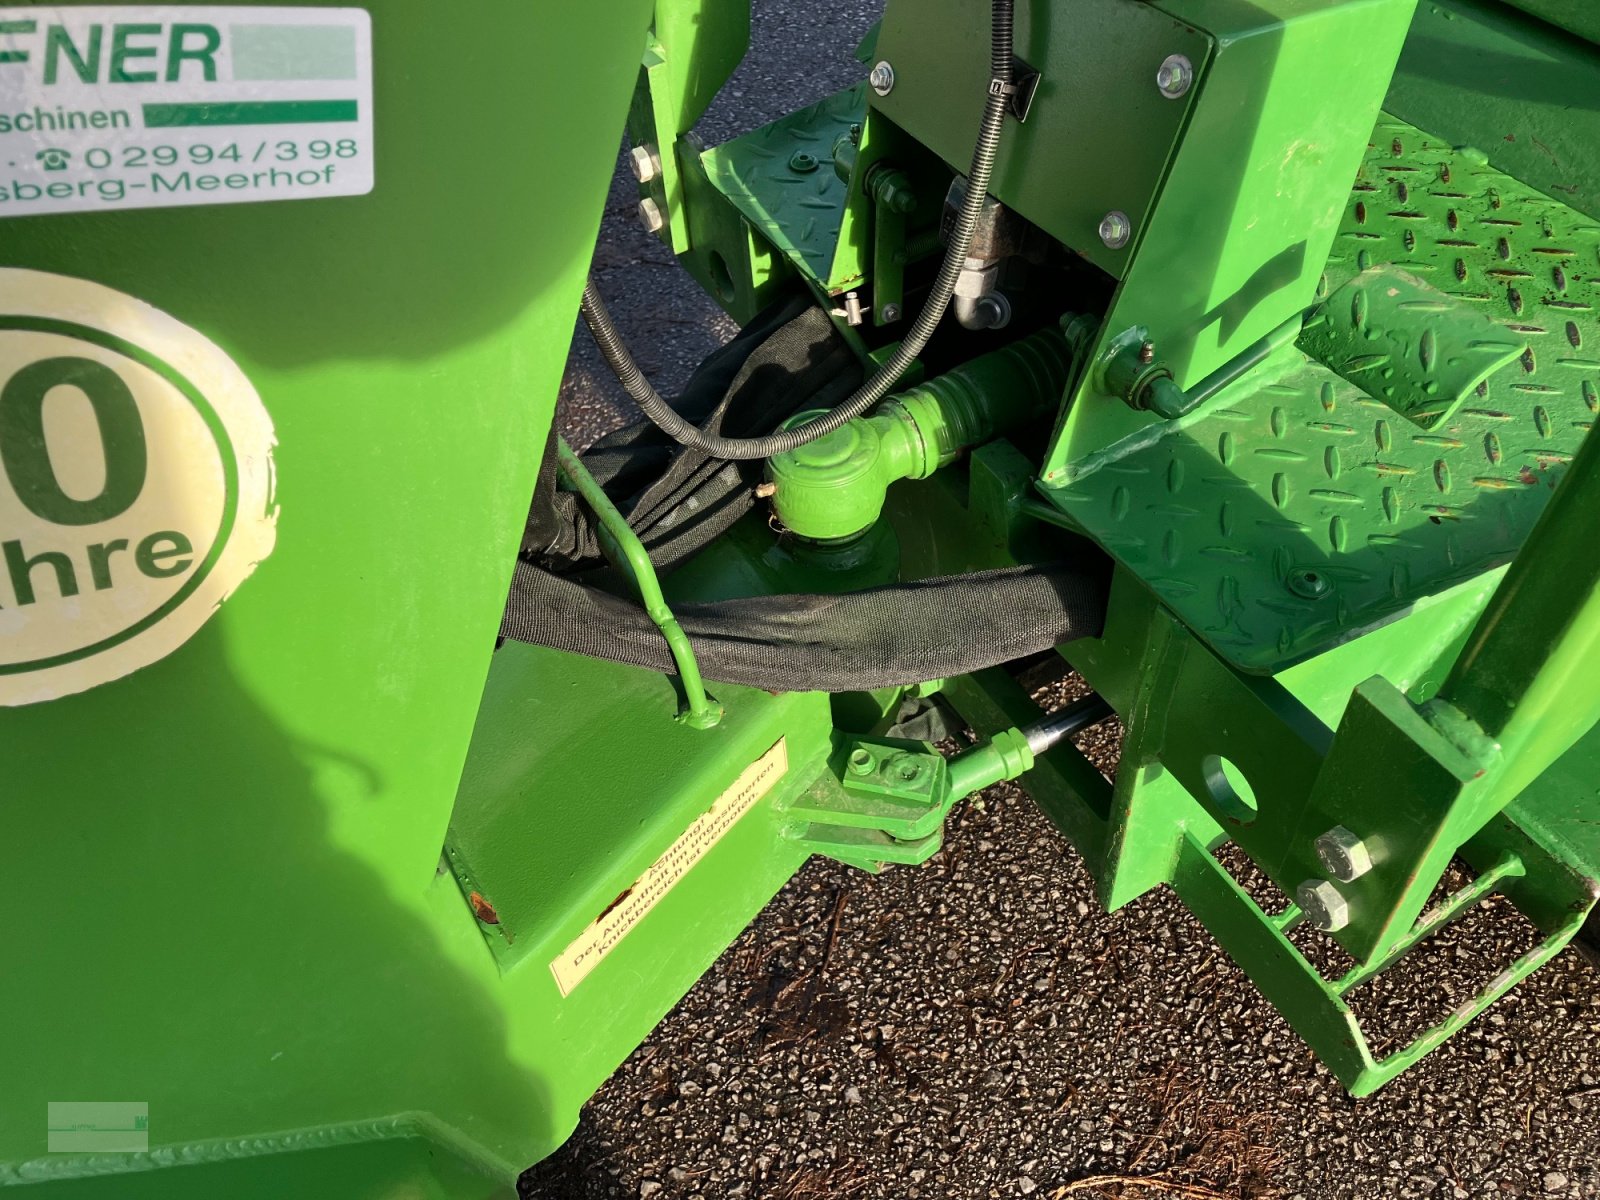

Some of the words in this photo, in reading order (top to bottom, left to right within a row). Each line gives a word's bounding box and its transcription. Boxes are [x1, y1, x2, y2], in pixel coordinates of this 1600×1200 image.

[0, 530, 193, 610] hre
[573, 942, 600, 967] Der
[602, 870, 670, 939] Aufenthalt
[672, 850, 688, 868] im
[691, 761, 775, 848] ungesicherten
[597, 868, 684, 956] Knickbereich
[685, 848, 702, 866] ist
[703, 791, 759, 847] verboten.
[648, 818, 706, 879] Achtung!
